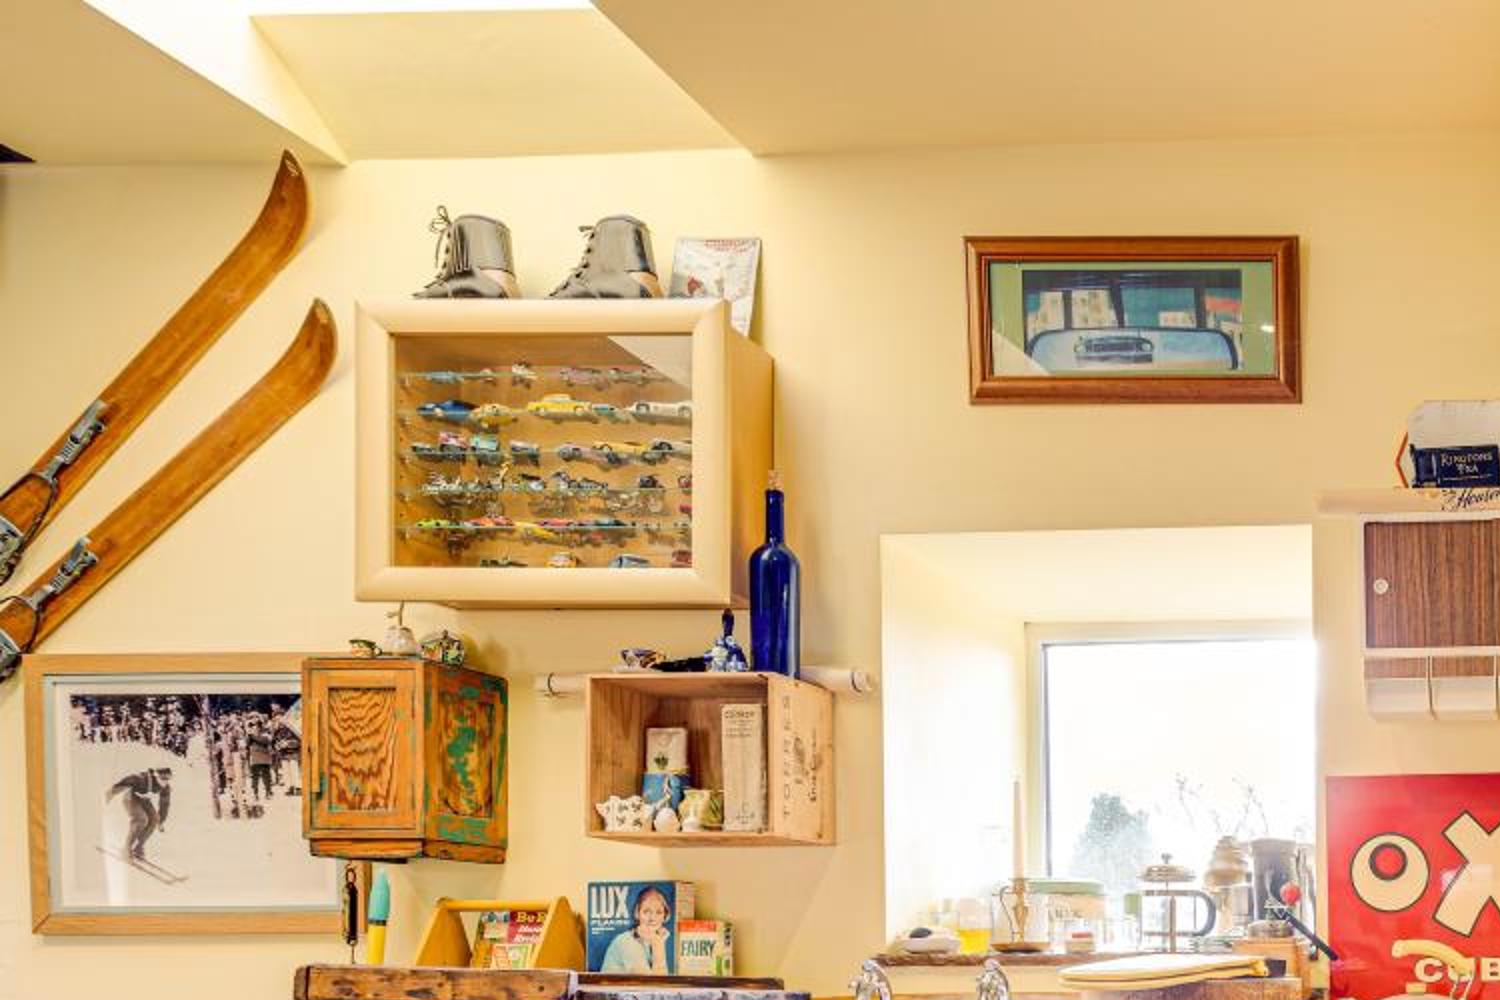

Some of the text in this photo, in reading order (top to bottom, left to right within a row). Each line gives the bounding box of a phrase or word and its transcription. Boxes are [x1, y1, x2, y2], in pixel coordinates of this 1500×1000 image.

[1441, 452, 1493, 466] RINGTONS
[591, 886, 630, 919] LUX
[682, 939, 716, 957] FAIRY
